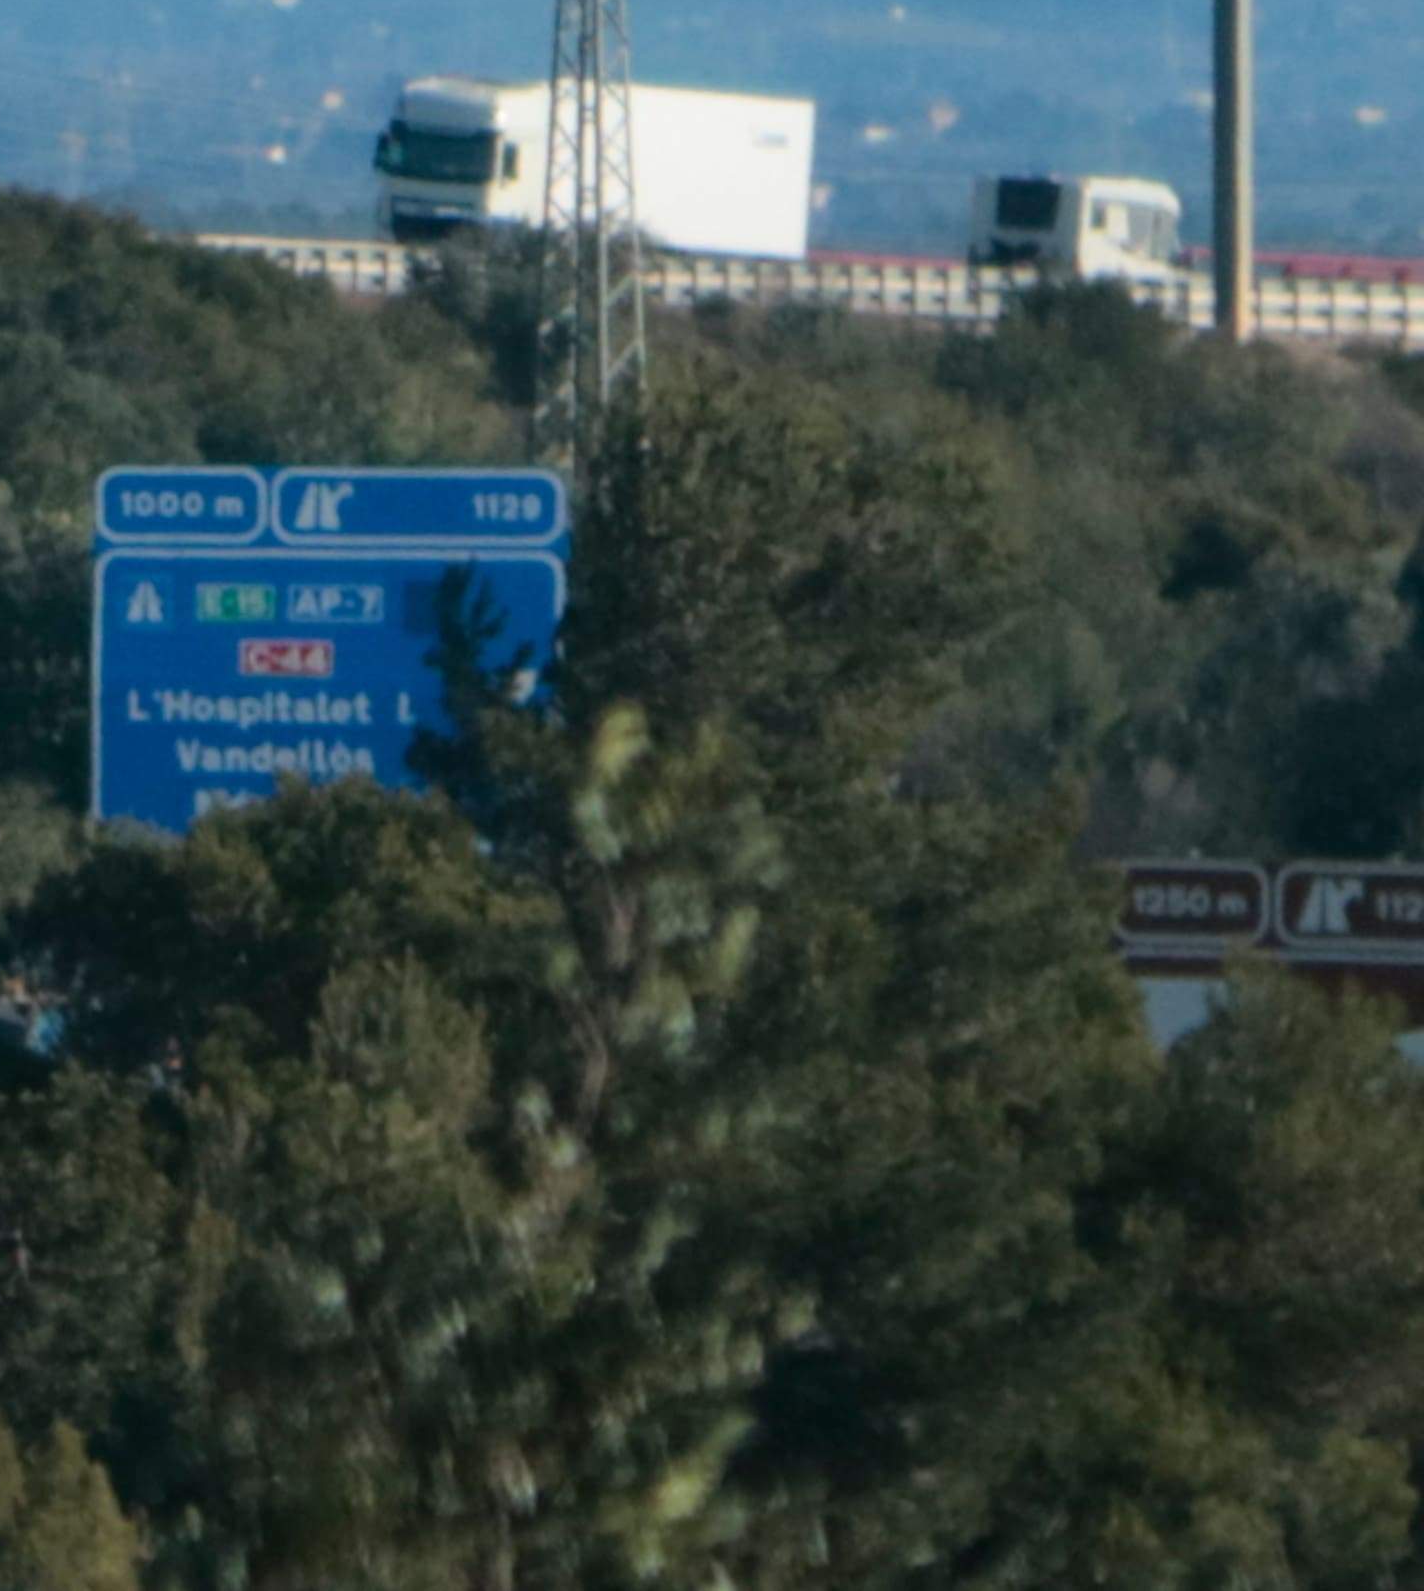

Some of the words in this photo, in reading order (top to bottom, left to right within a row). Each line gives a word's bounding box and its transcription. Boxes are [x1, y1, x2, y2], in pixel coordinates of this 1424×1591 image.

[121, 491, 204, 518] 1000
[215, 496, 245, 518] m
[295, 587, 379, 617] AP-7
